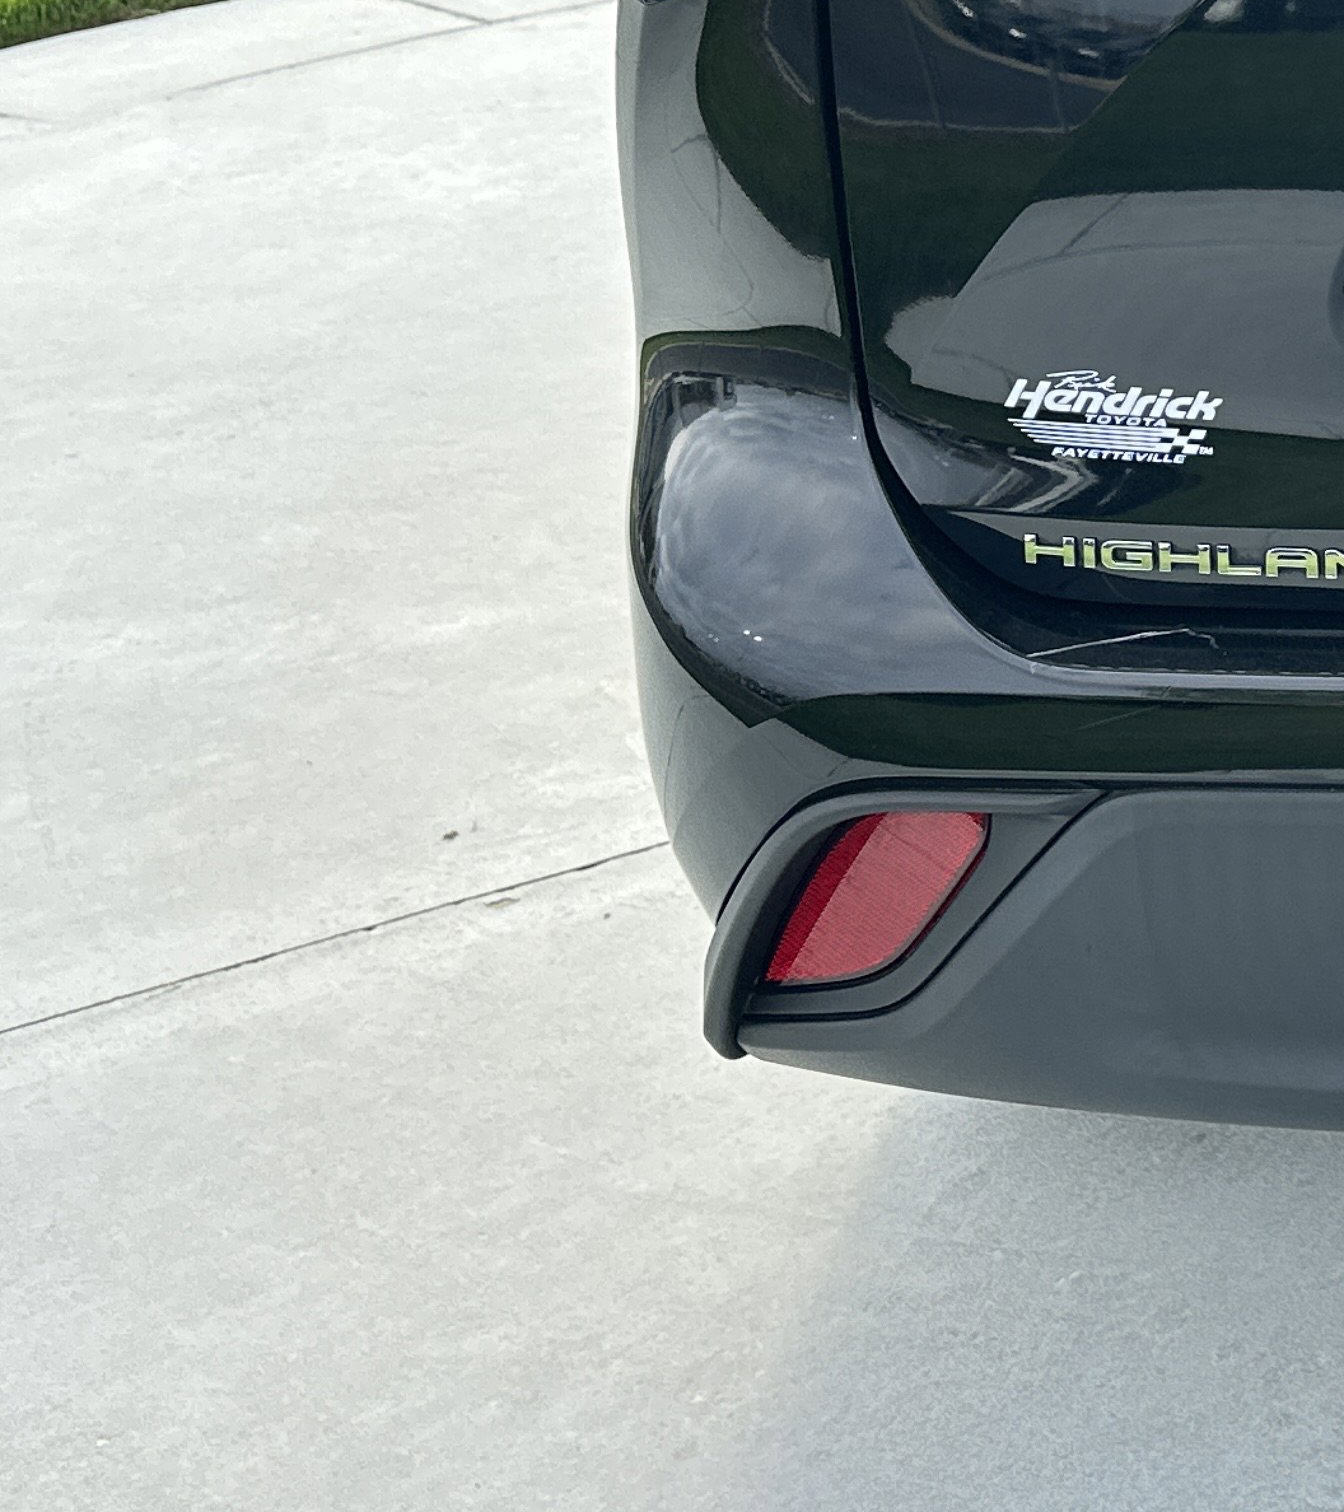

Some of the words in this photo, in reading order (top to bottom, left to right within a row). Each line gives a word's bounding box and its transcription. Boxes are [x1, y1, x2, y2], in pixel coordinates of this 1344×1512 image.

[1004, 378, 1224, 420] Hendrick
[1084, 414, 1168, 428] TOYOTA
[1051, 446, 1187, 464] FAYETTEVILLE
